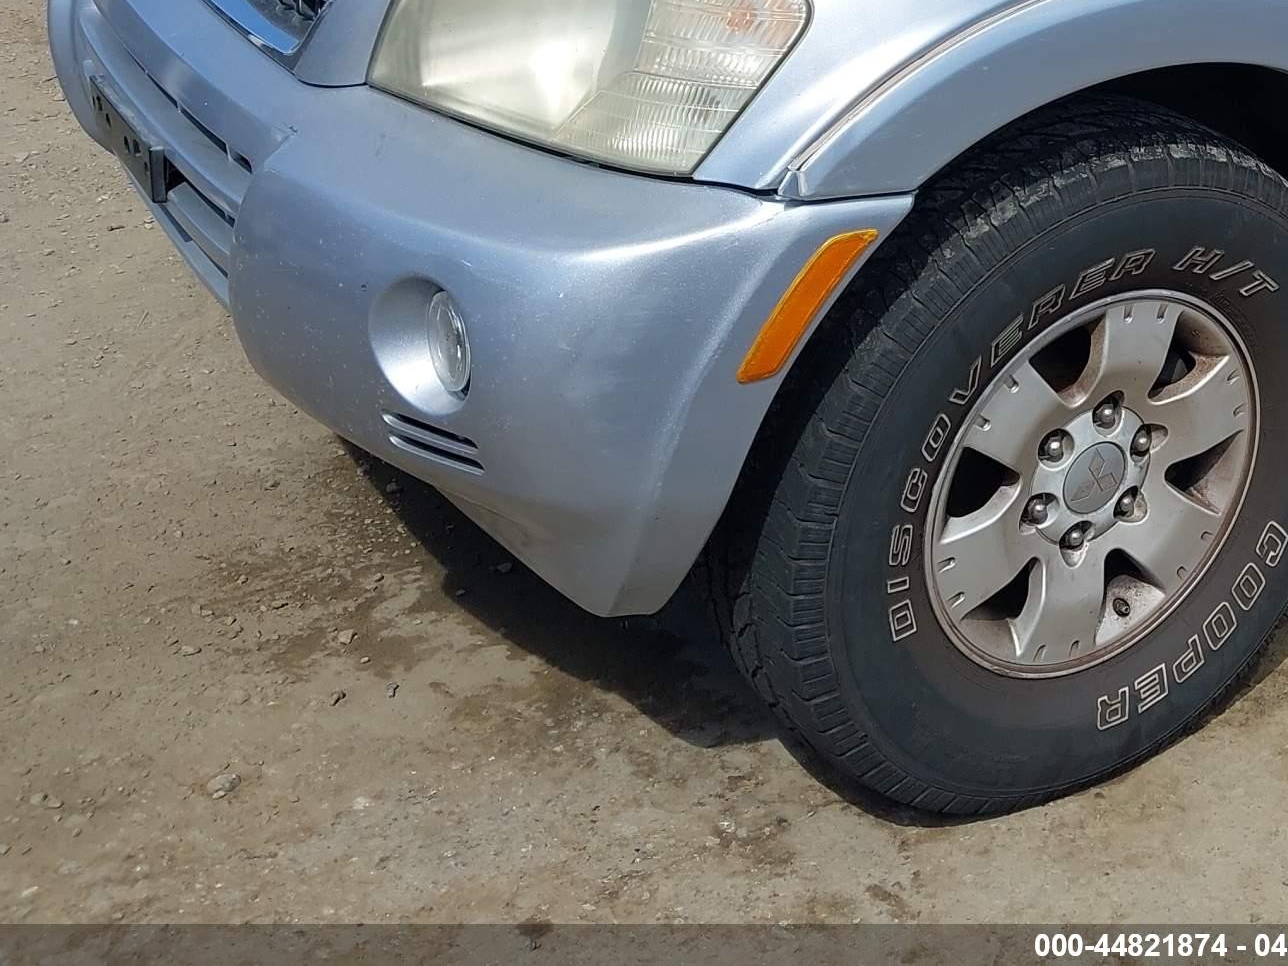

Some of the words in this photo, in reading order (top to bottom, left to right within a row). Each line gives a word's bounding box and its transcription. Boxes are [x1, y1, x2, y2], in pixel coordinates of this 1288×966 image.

[887, 248, 1156, 640] DISCOVERER
[1172, 245, 1280, 298] H/T
[1096, 520, 1288, 731] COOPER
